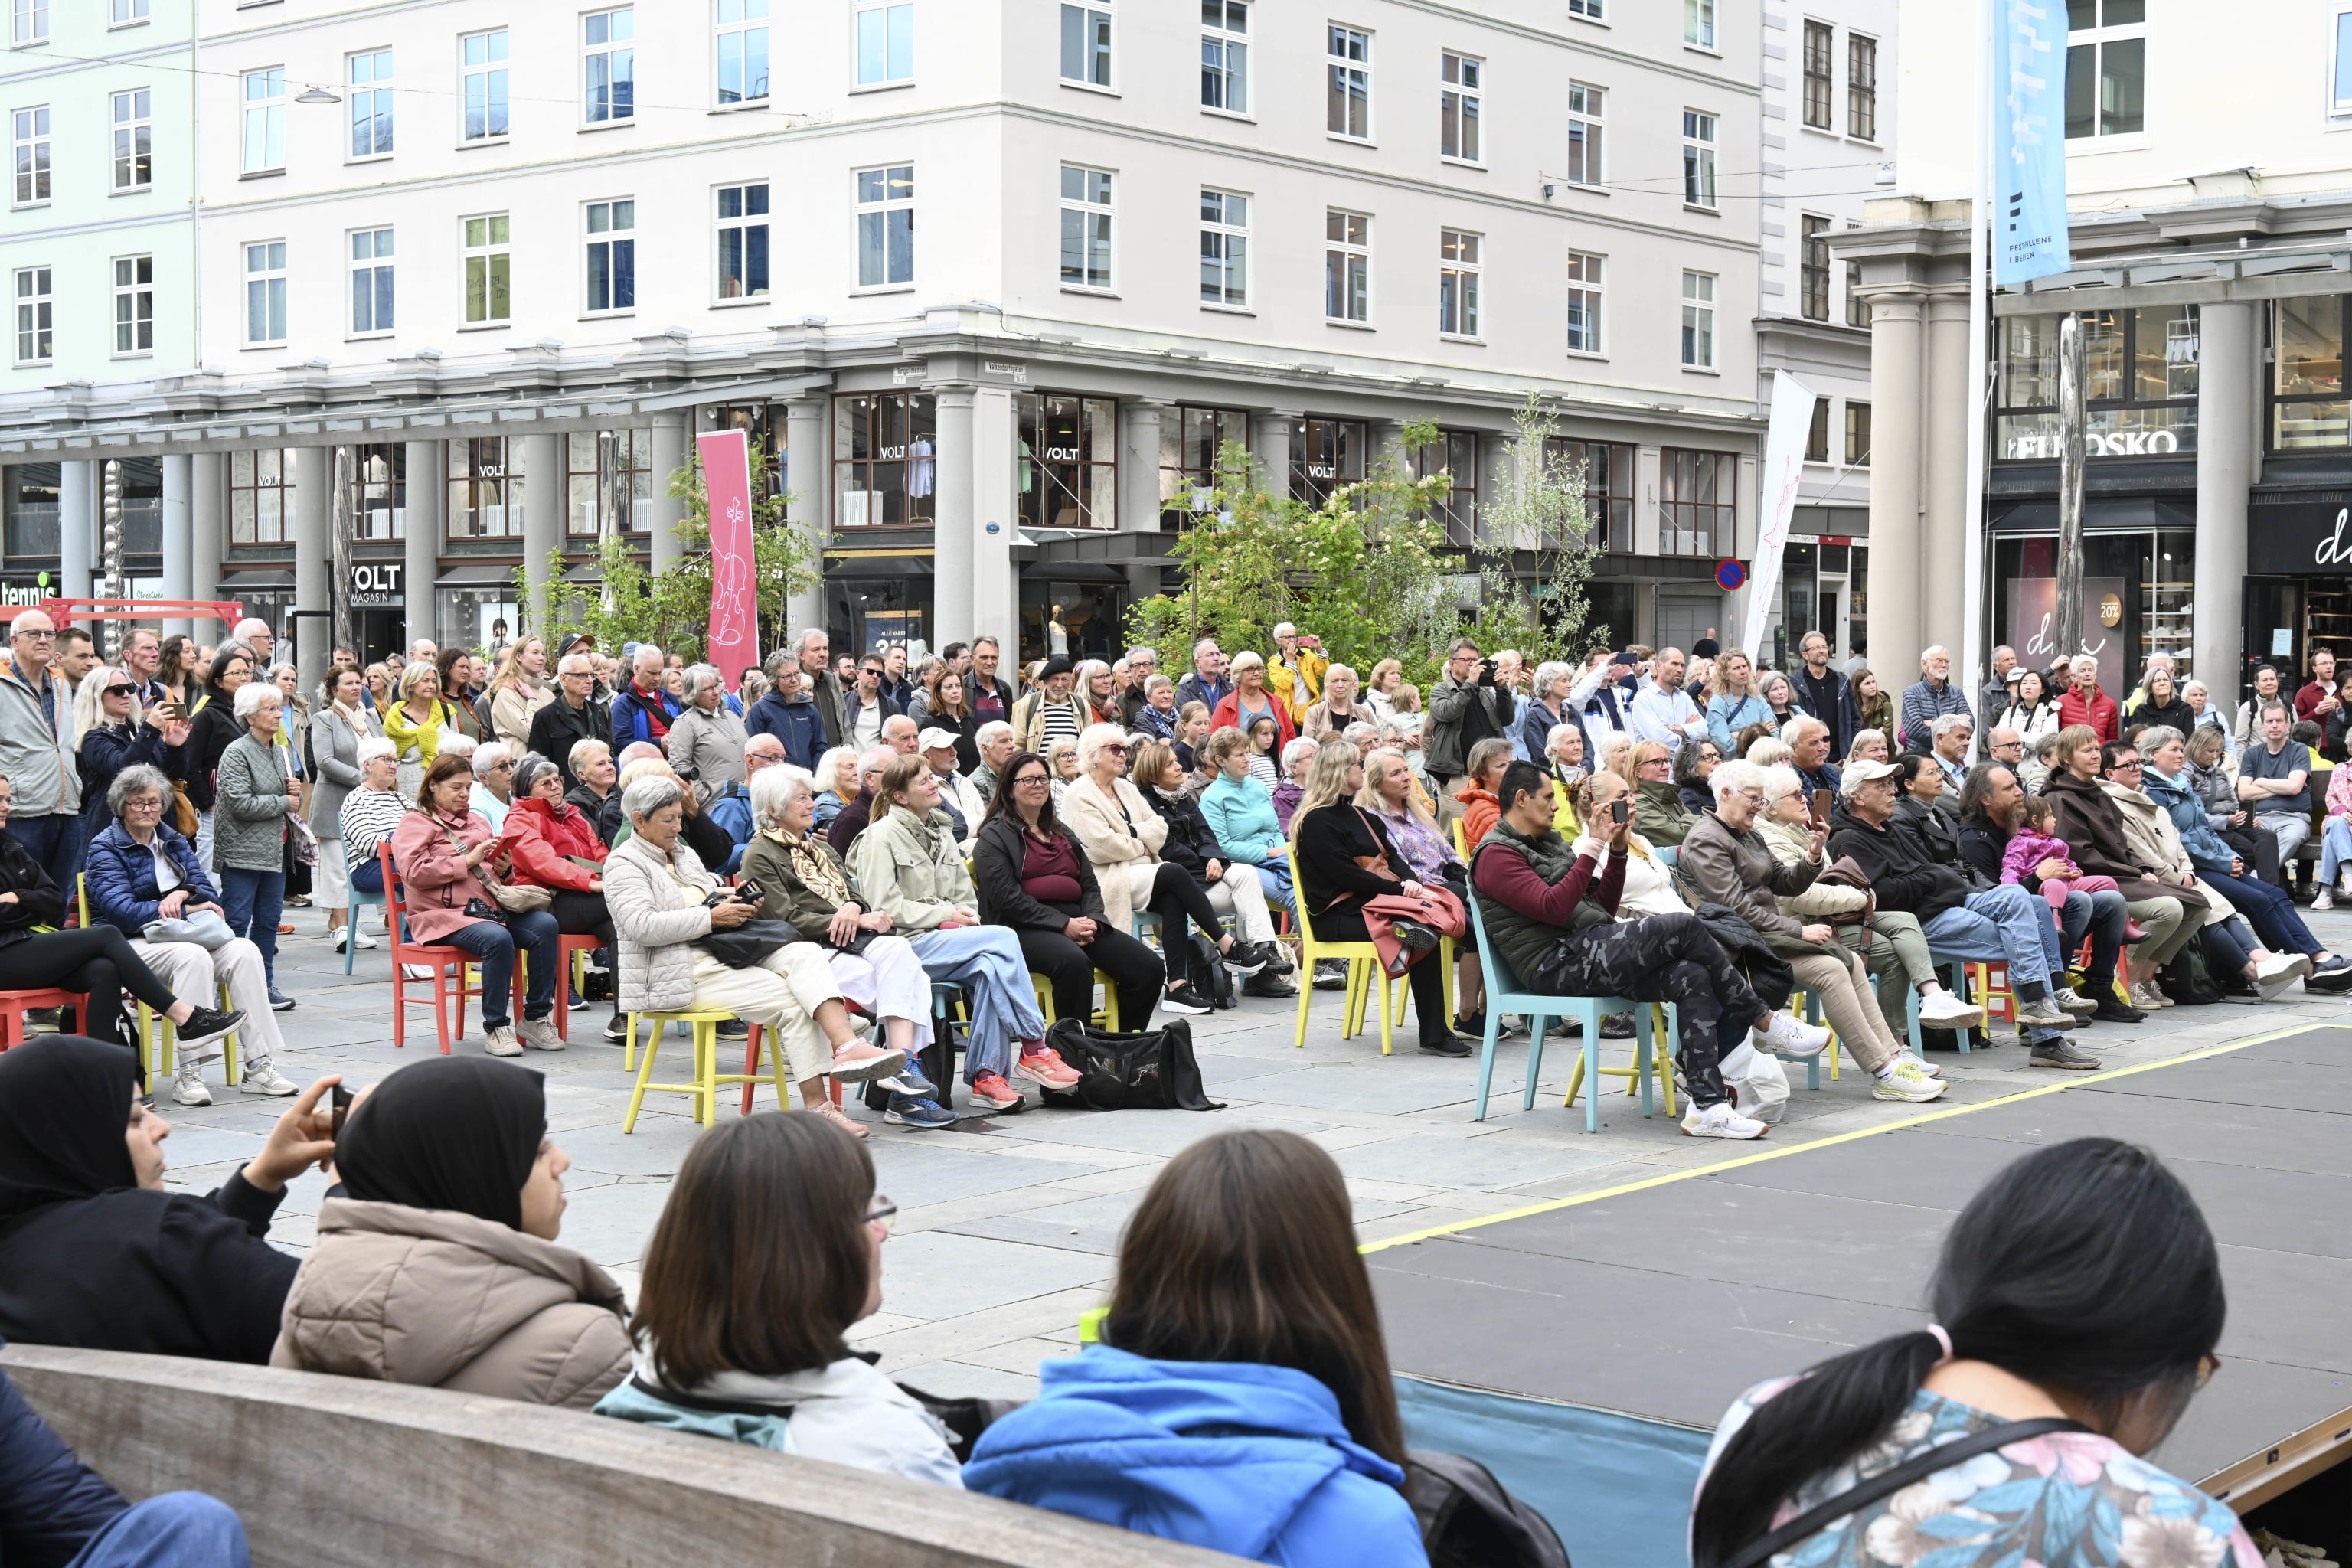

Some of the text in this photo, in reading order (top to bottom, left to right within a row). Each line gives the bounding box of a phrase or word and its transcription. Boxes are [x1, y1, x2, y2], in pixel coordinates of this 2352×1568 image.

[2017, 430, 2177, 459] EUOSKO
[880, 446, 905, 459] VOLT
[479, 465, 505, 477] VOLT
[1308, 466, 1335, 478] VOLT
[259, 475, 280, 486] VOLT
[136, 590, 164, 600] Streetwea
[351, 592, 388, 603] MAGASIN
[2100, 605, 2119, 618] 20%
